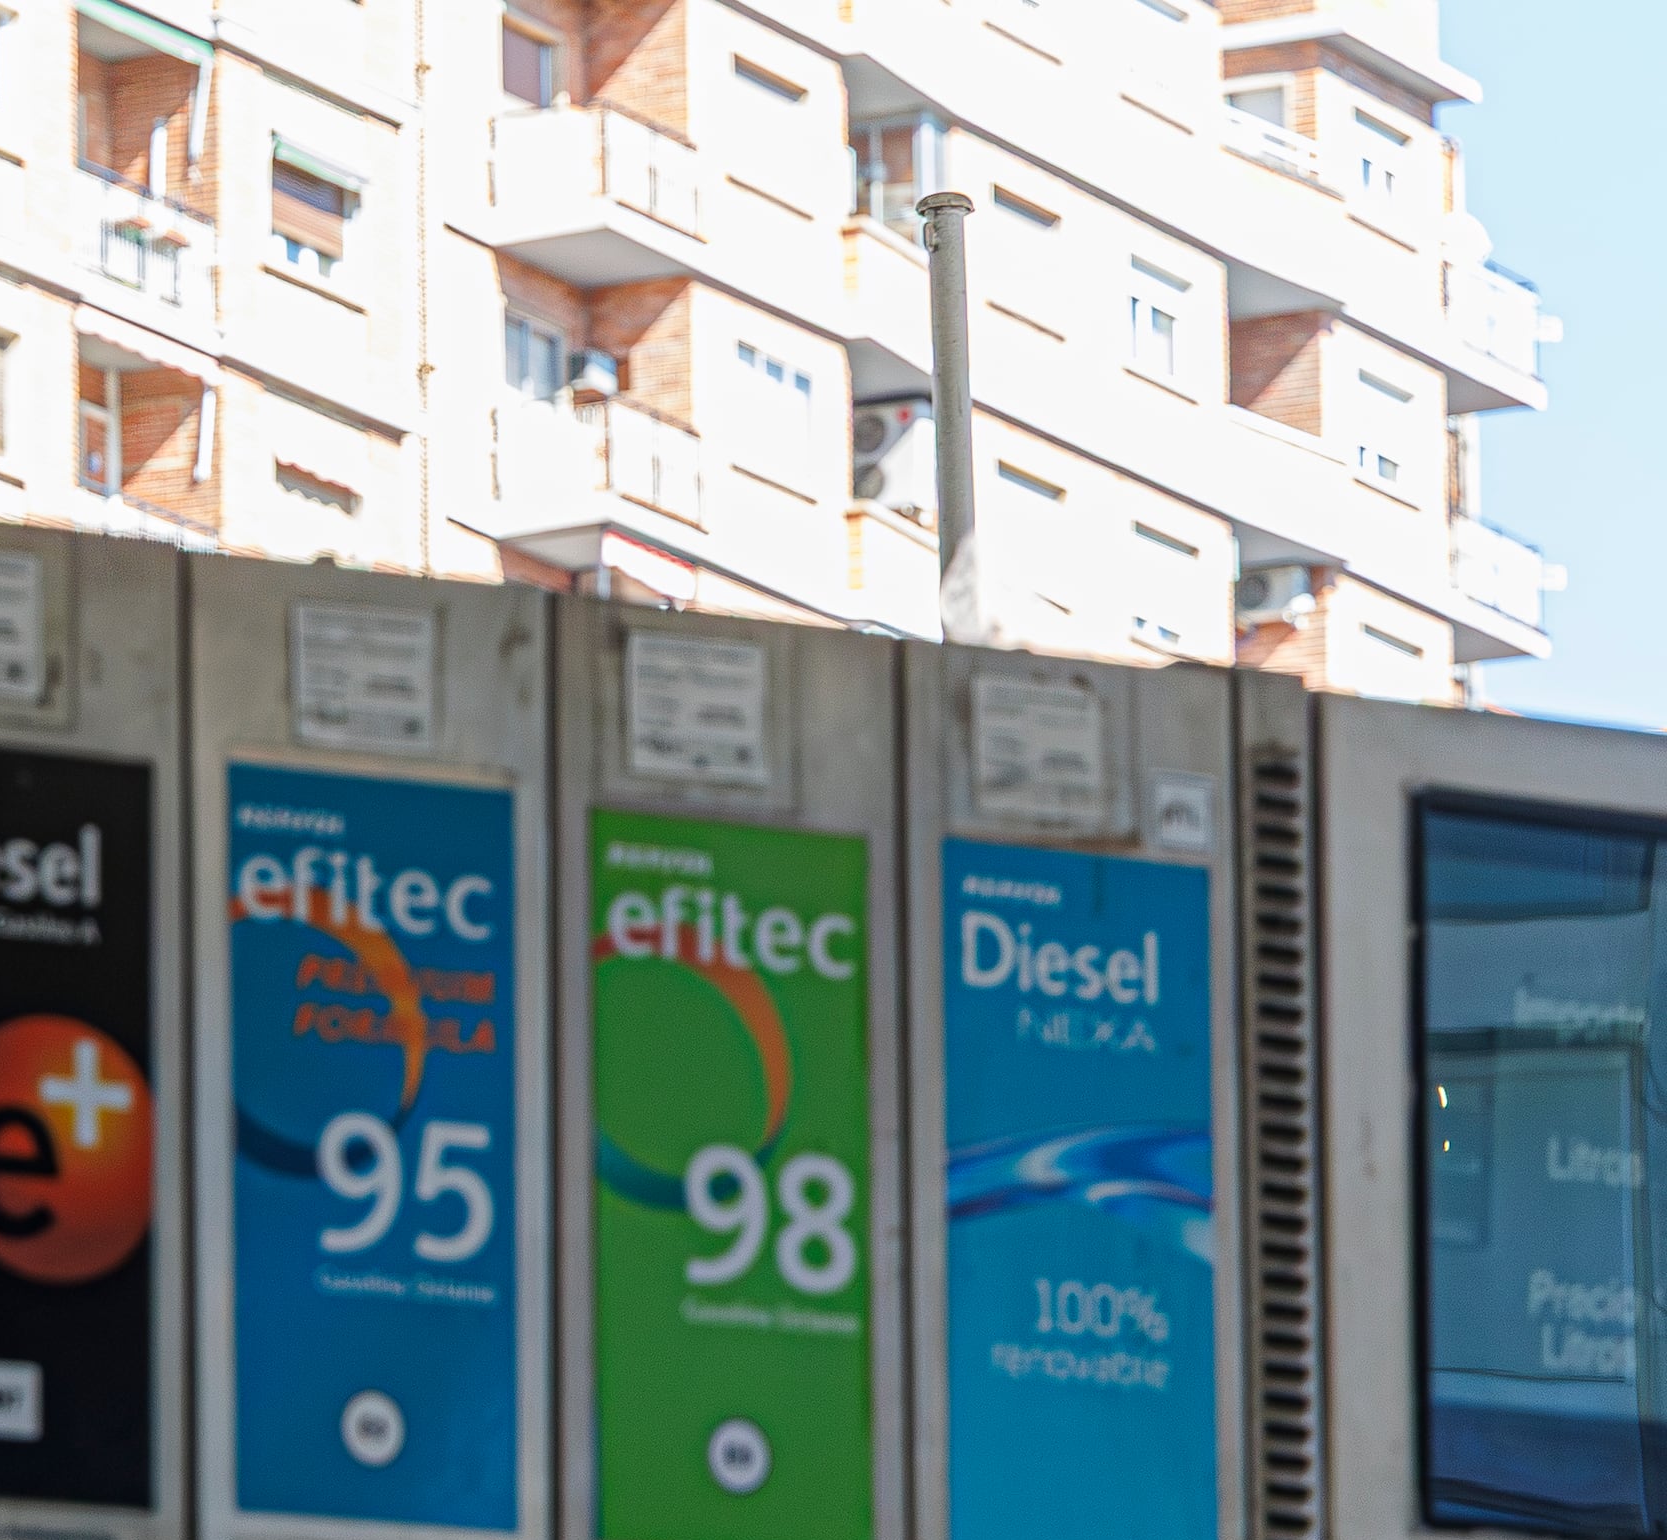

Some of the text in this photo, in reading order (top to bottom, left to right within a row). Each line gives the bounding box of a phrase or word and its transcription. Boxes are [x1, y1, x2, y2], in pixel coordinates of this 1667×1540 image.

[236, 846, 496, 942] efitec
[607, 884, 857, 982] efitec
[961, 908, 1160, 1007] Diesel
[315, 1110, 495, 1264] 95
[683, 1141, 859, 1296] 98
[1033, 1277, 1170, 1344] 100%
